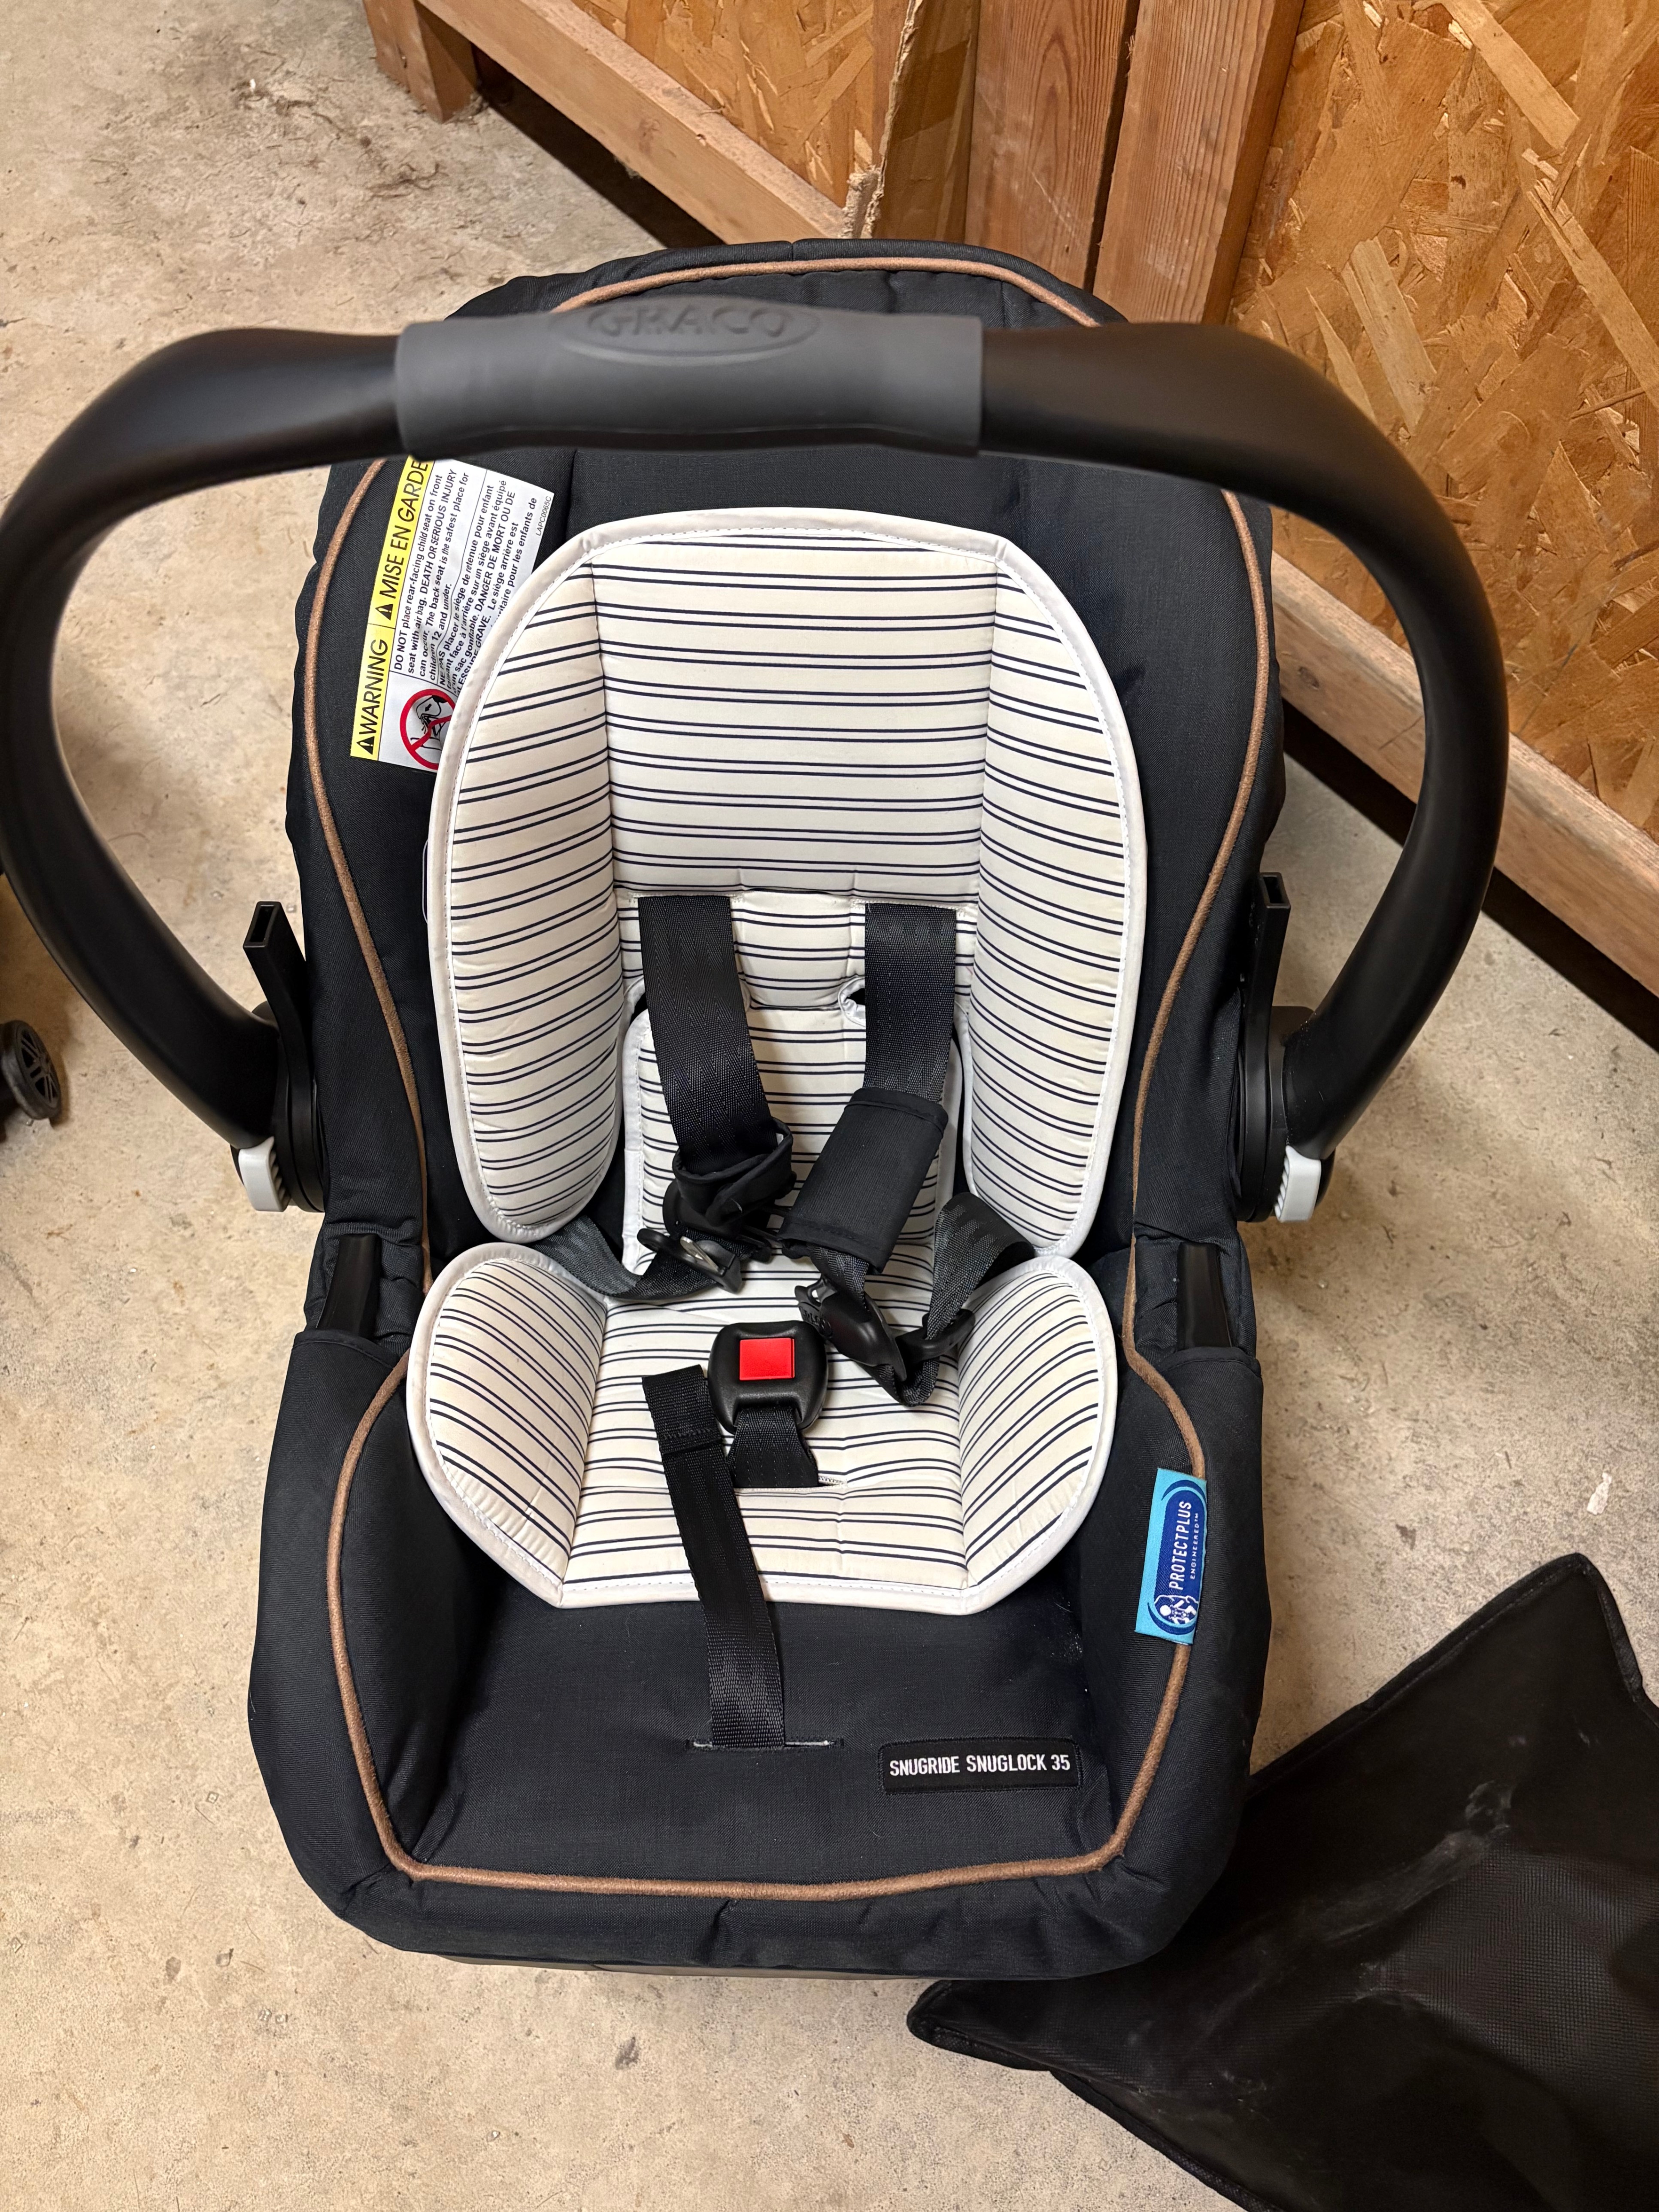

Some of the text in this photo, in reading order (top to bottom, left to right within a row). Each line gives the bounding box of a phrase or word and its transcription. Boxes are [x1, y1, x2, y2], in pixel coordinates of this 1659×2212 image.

[587, 306, 793, 338] GRACO
[441, 469, 457, 503] INJURY
[460, 472, 469, 486] for
[453, 487, 464, 512] place
[481, 485, 494, 514] enfant
[493, 480, 506, 511] équipé
[505, 491, 516, 505] DE
[431, 505, 446, 545] SERIOUS
[486, 512, 497, 539] avant
[501, 507, 511, 522] OU
[536, 496, 551, 536] LAPC0065C
[379, 460, 428, 599] MISE EN GARDE
[445, 513, 457, 542] safest
[474, 515, 485, 538] pour
[492, 523, 506, 553] MORT
[428, 545, 437, 559] OR
[441, 543, 450, 555] the
[478, 540, 490, 567] siège
[507, 563, 518, 587] pour
[519, 512, 533, 547] enfants
[528, 498, 537, 509] de
[442, 555, 448, 564] is
[466, 539, 478, 573] retenue
[487, 555, 497, 570] DE
[394, 475, 442, 670] DO NOT place rear-facing child seat on front
[420, 561, 434, 594] DEATH
[435, 565, 445, 585] seat
[462, 574, 470, 585] de
[475, 568, 482, 579] un
[471, 579, 479, 596] sur
[474, 571, 493, 612] DANGER
[476, 615, 491, 648] GRAVE.
[488, 598, 497, 610] Le
[494, 572, 504, 597] siège
[500, 539, 513, 570] arrière
[510, 522, 519, 537] est
[415, 597, 428, 616] bag.
[429, 587, 440, 609] back
[443, 584, 452, 610] under.
[453, 588, 465, 612] siège
[425, 611, 435, 627] The
[439, 611, 448, 630] and
[454, 613, 459, 621] le
[411, 630, 419, 651] with
[431, 631, 442, 640] 12
[444, 623, 459, 651] placer
[465, 614, 479, 658] gonflable.
[450, 641, 464, 659] face
[408, 653, 416, 674] seat
[455, 658, 467, 672] sac
[359, 639, 388, 734] WARNING
[440, 671, 445, 685] NE
[1169, 1501, 1191, 1590] PROTECTPLUS
[890, 1754, 1071, 1776] SNUGRIDE SNUGLOCK 35
